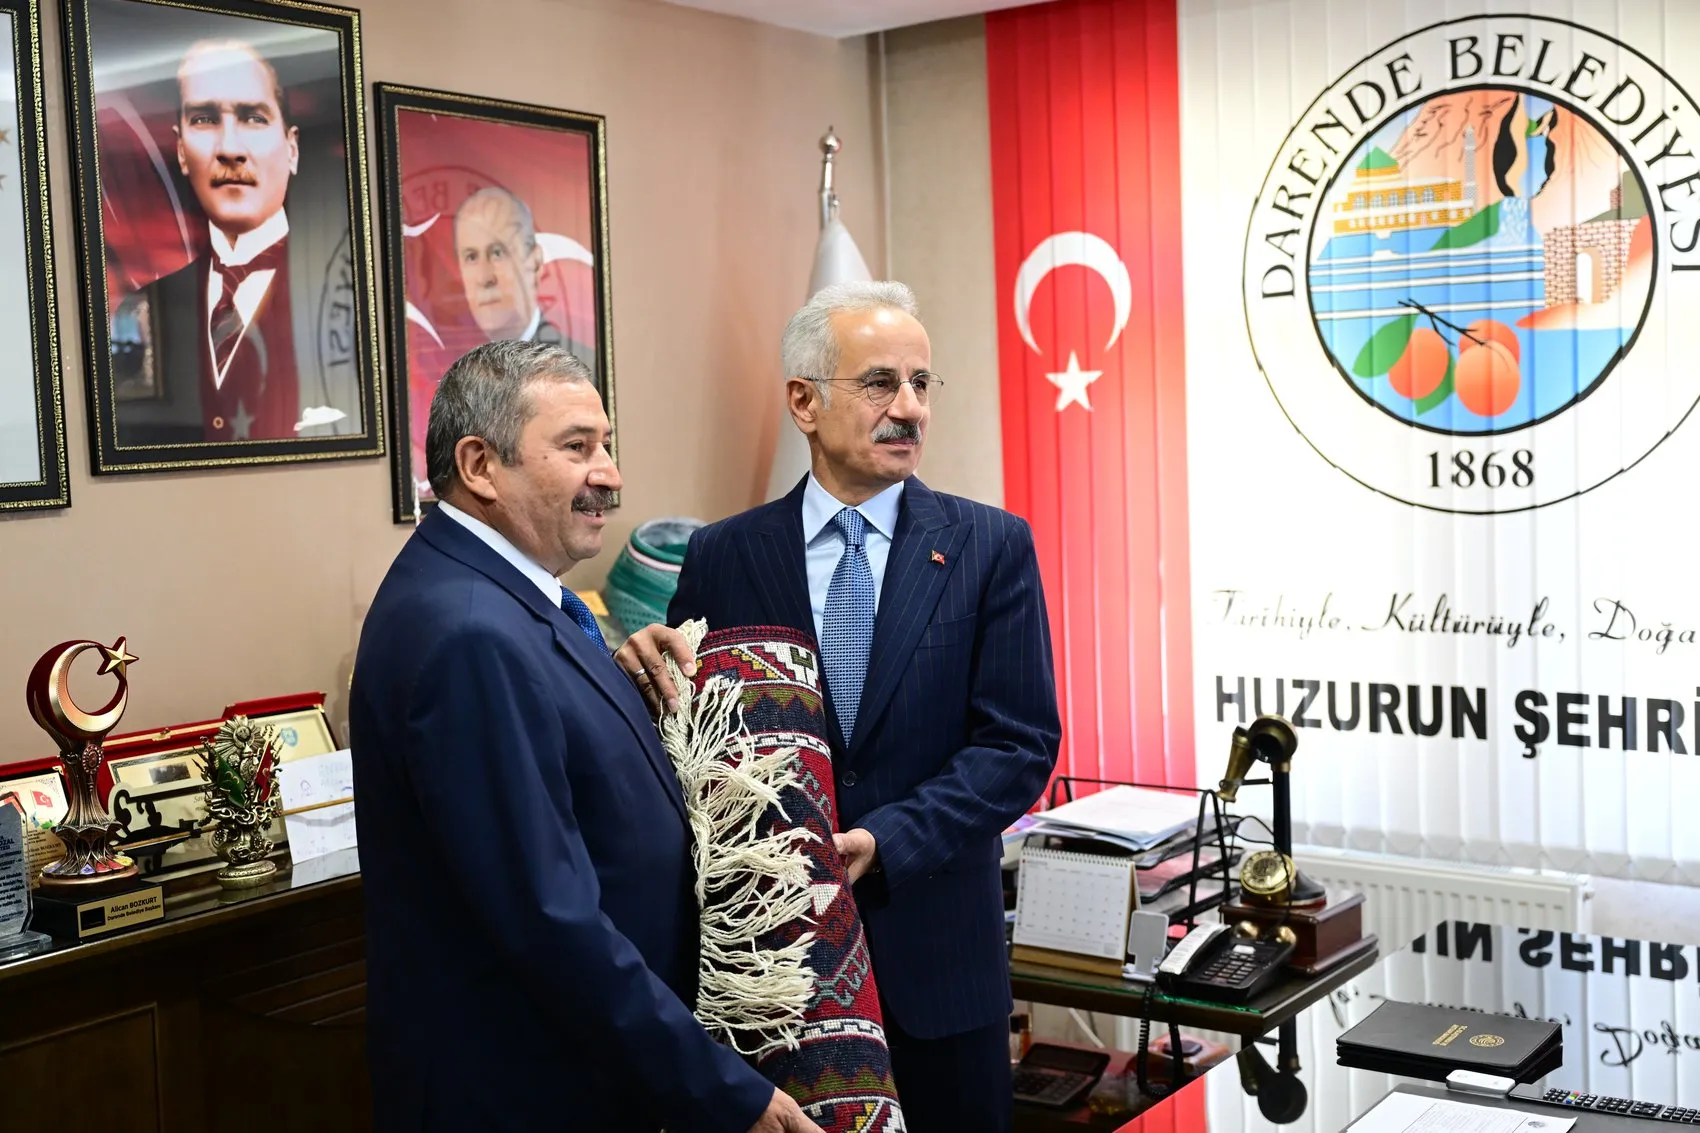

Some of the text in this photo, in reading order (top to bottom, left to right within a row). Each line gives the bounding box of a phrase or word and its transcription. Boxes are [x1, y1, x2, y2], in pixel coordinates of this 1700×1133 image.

[1261, 53, 1422, 299] DARENDE
[1427, 448, 1535, 489] 1868
[1588, 597, 1696, 656] Doğa
[1215, 675, 1488, 740] HUZURUN
[129, 896, 157, 908] BOZKURT
